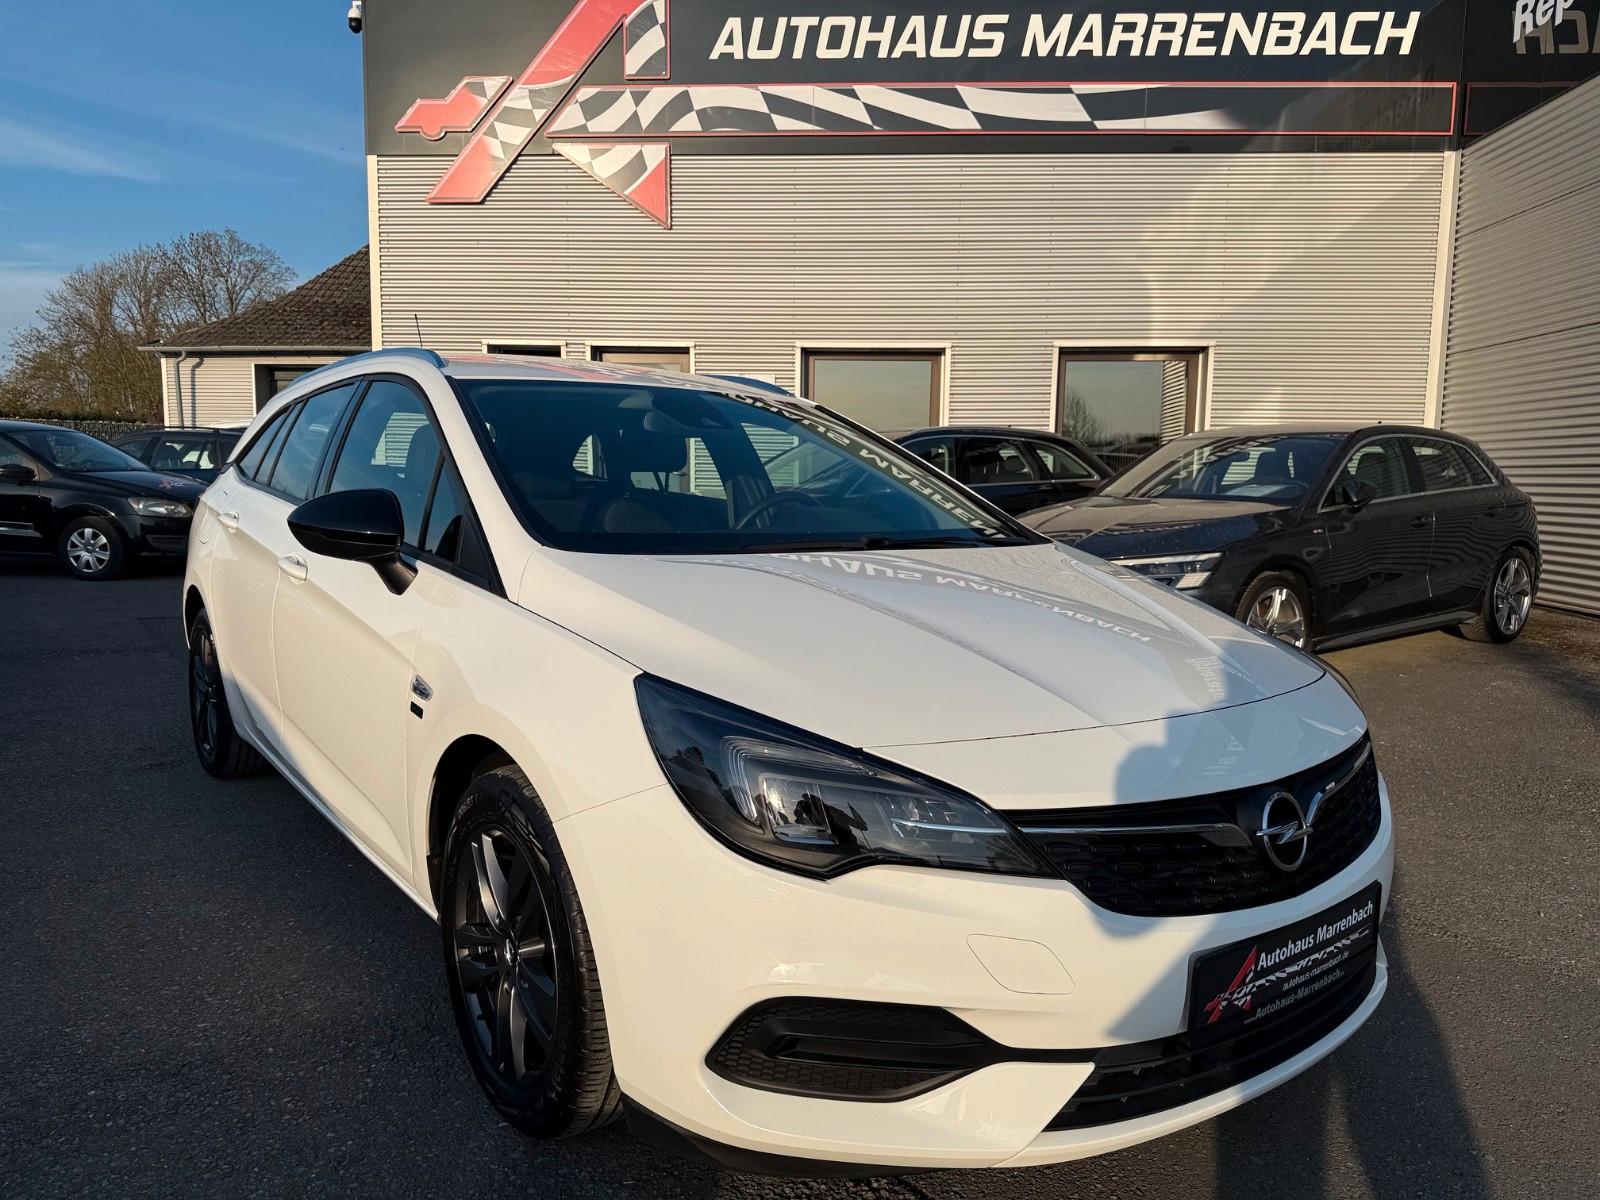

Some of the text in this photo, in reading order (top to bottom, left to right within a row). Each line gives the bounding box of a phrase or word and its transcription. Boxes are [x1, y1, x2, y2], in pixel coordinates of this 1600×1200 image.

[709, 11, 1421, 60] AUTOHAUS MARRENBACH
[1257, 901, 1373, 971] Autohaus Marrenbach
